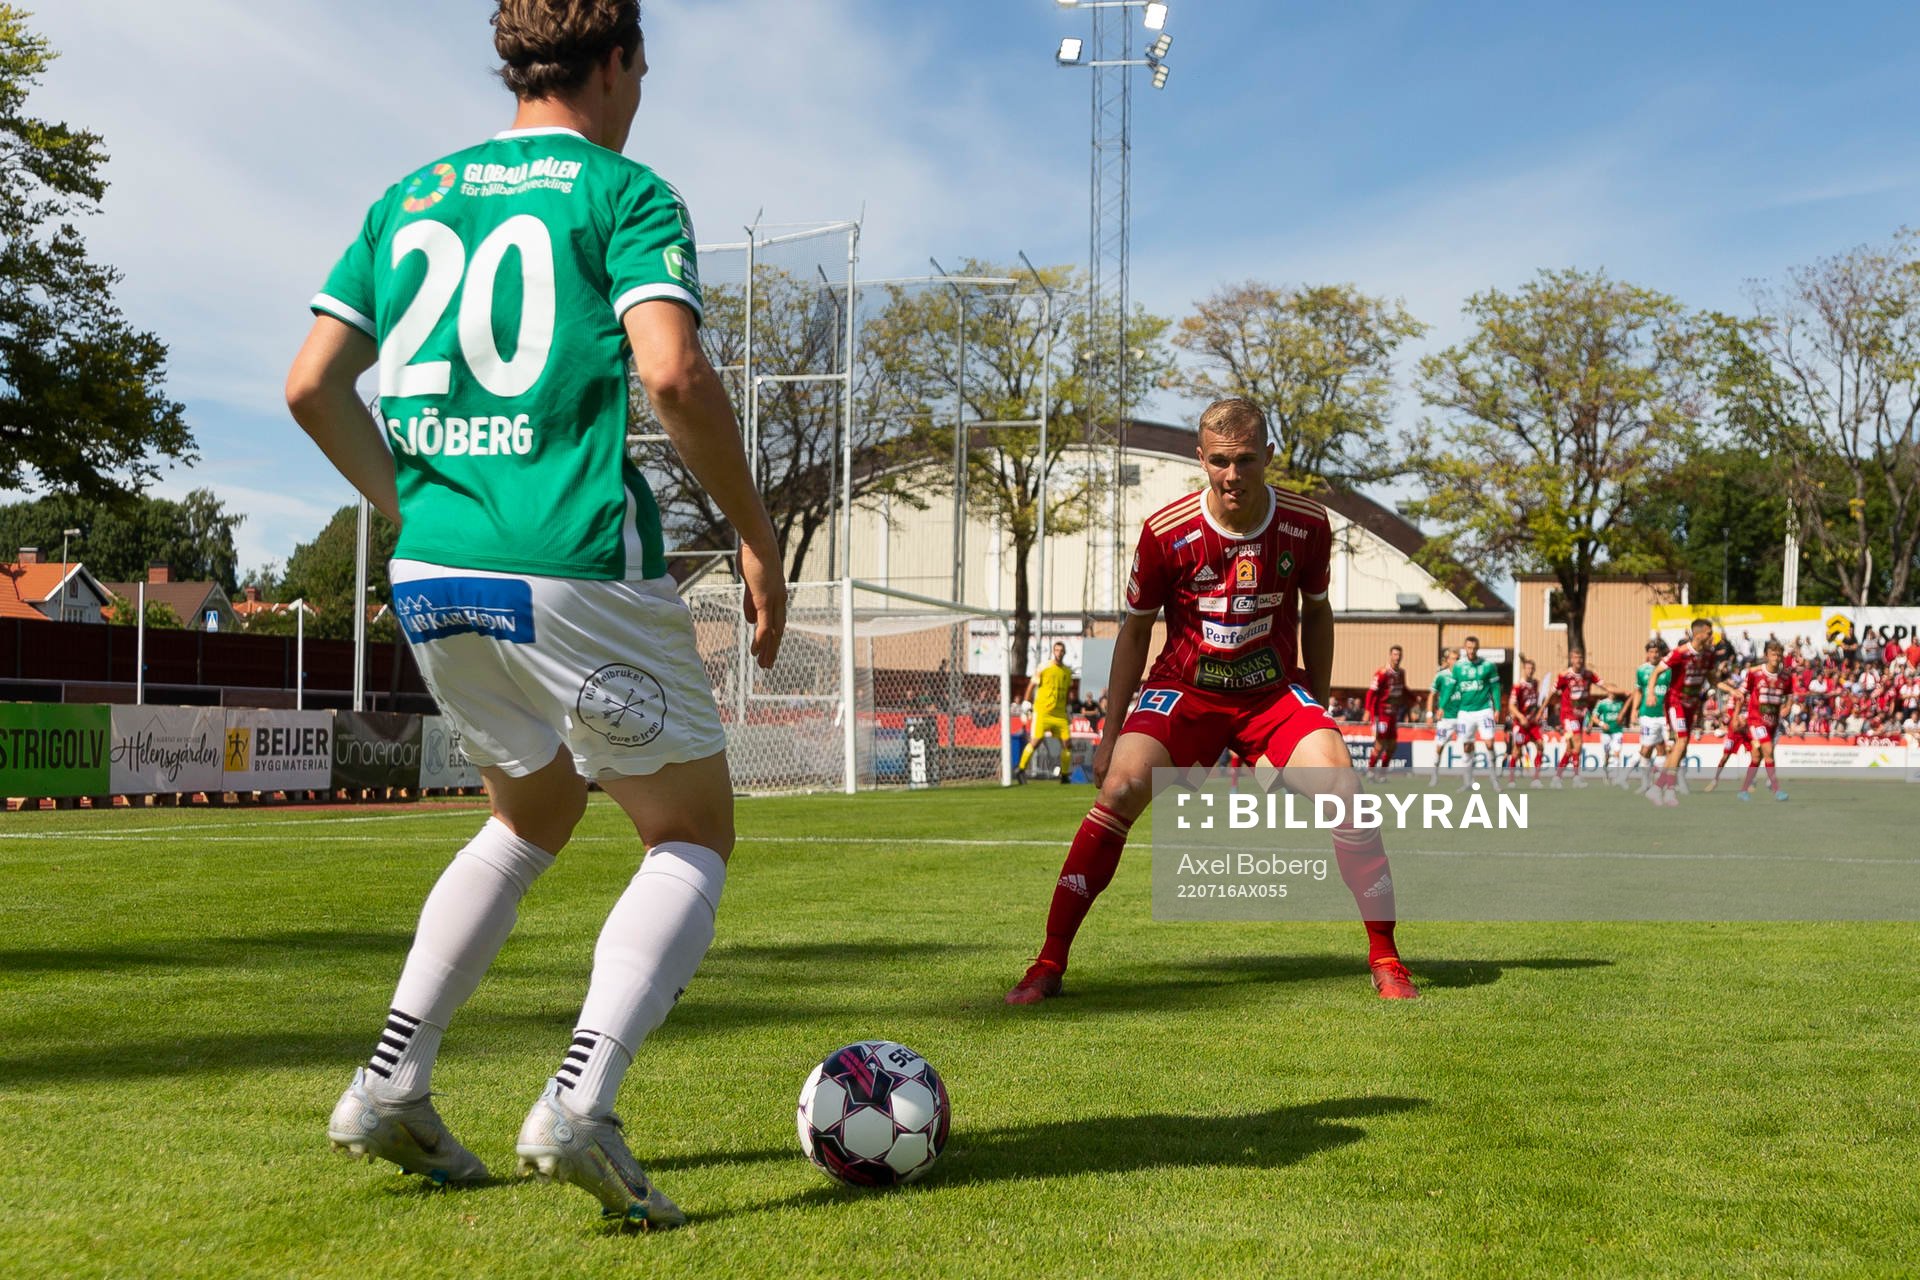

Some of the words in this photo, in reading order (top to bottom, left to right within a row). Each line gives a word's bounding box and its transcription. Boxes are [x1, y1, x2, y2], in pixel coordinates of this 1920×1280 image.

[379, 213, 556, 398] 20
[387, 407, 533, 456] SJÖBERG
[255, 728, 329, 756] BEIJER
[255, 759, 328, 771] BYGGMATERIAL
